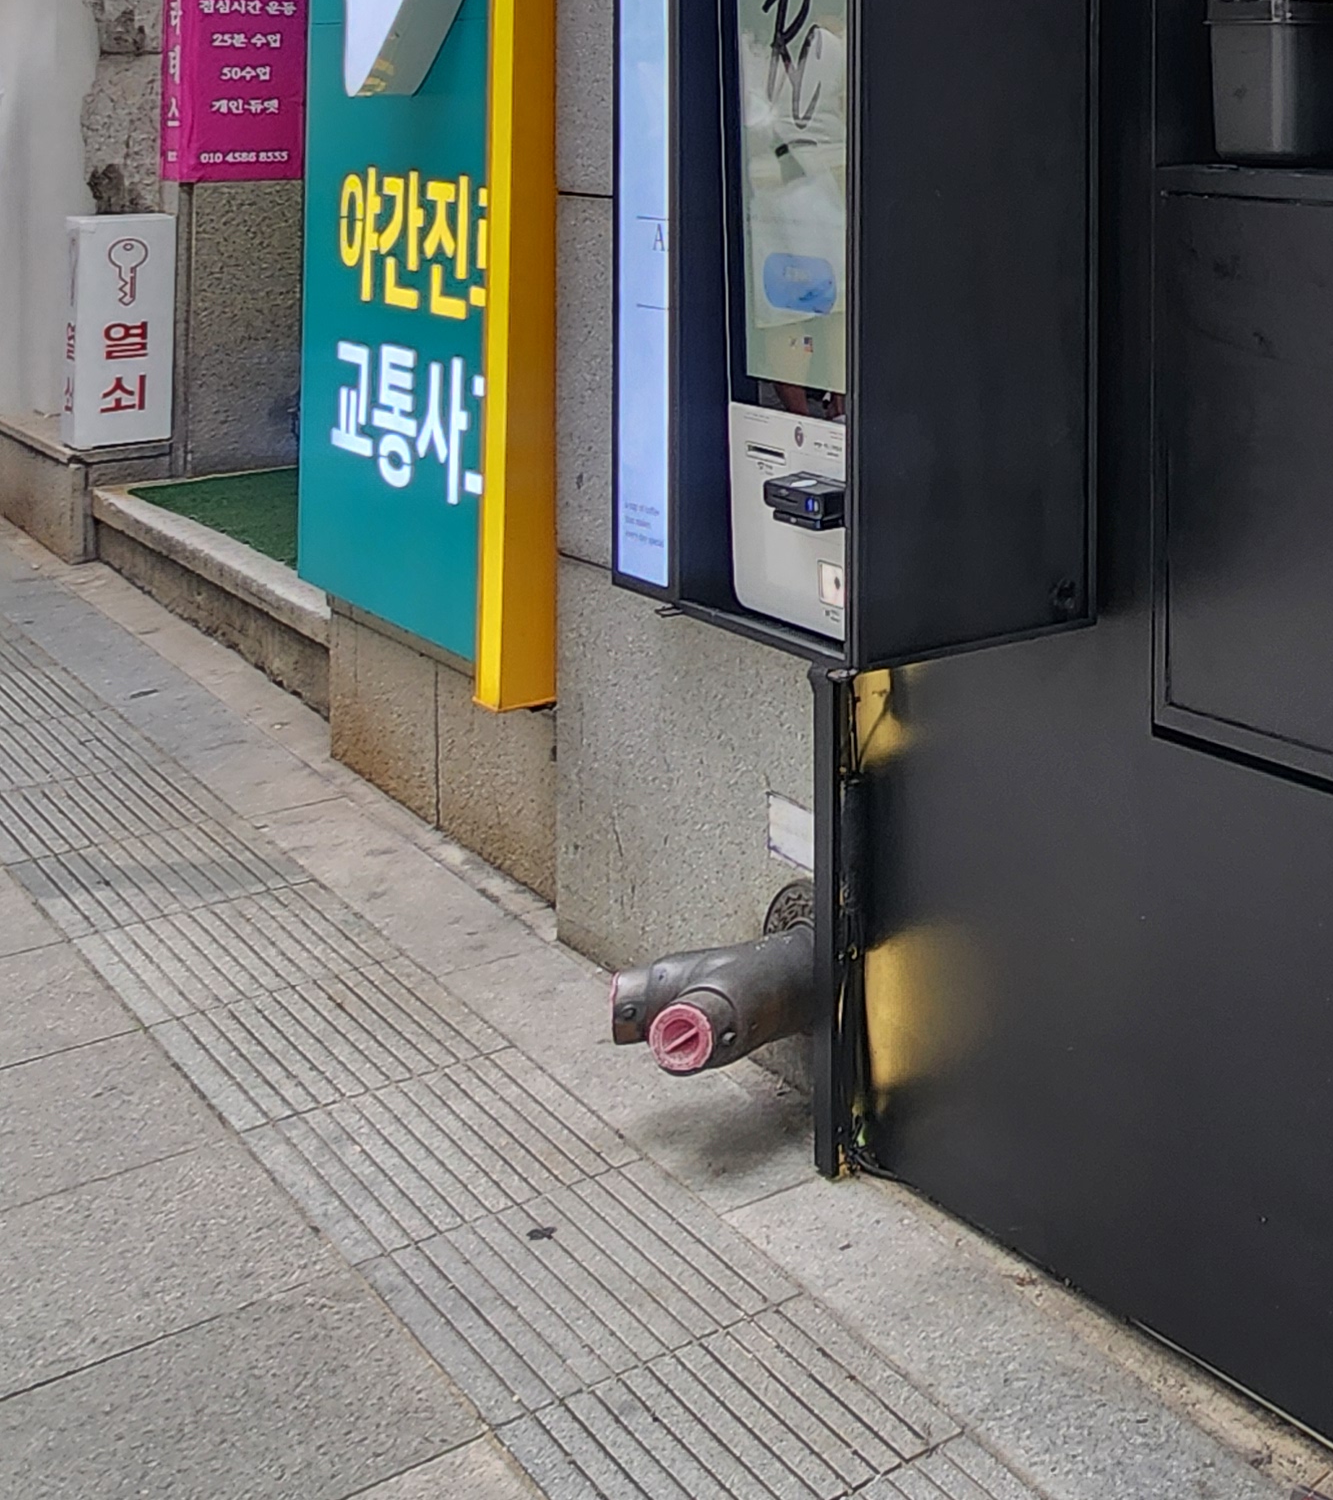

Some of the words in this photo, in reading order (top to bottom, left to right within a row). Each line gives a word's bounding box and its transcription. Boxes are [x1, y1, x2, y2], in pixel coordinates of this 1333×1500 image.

[199, 0, 262, 14] 점심시간
[265, 1, 297, 16] 운동
[212, 33, 247, 47] 25분
[251, 33, 281, 47] 수업
[220, 66, 271, 81] 50수업
[200, 152, 223, 164] 010
[100, 320, 148, 414] 열쇠
[330, 340, 485, 505] 교통사
